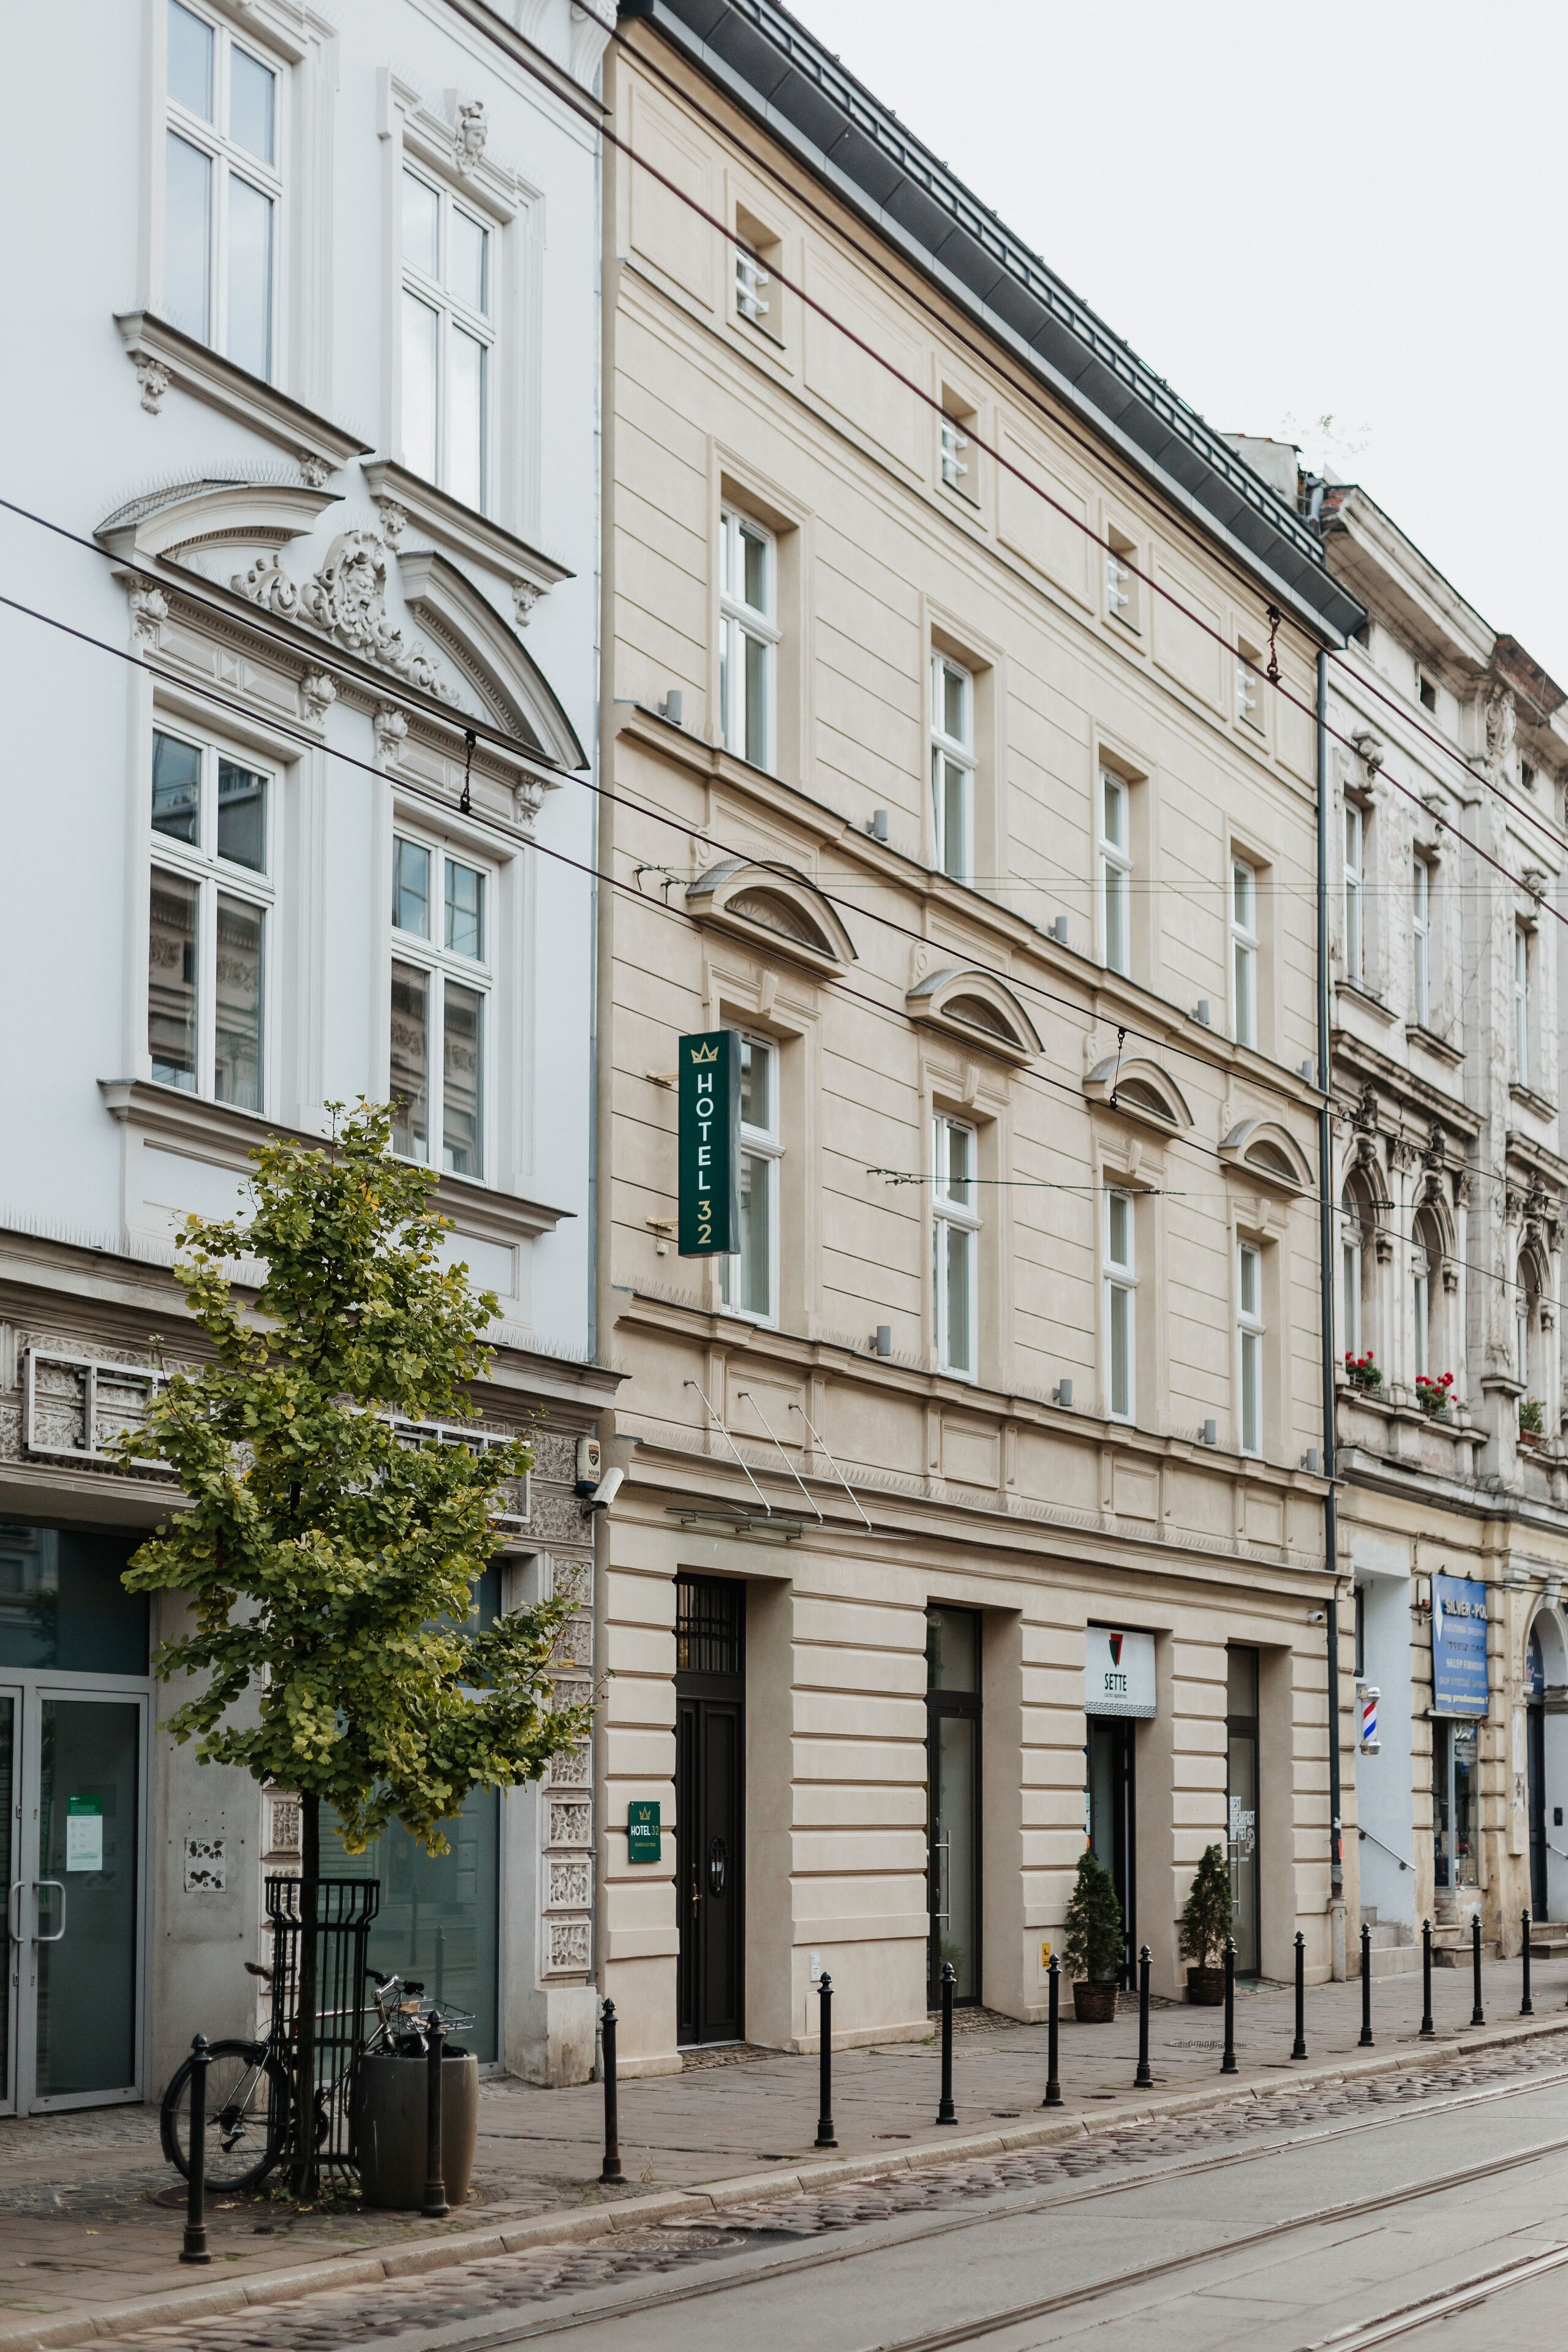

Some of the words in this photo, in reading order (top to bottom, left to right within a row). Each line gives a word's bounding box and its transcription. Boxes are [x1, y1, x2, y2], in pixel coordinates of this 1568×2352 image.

[696, 1072, 714, 1190] HOTEL
[697, 1200, 712, 1244] 32
[1444, 1598, 1470, 1616] SILVER
[1475, 1602, 1488, 1619] POL
[1105, 1673, 1126, 1691] SETTE
[1229, 1796, 1242, 1811] BEST
[1229, 1811, 1255, 1826] BREAKFAST
[631, 1825, 650, 1836] HOTEL
[652, 1825, 659, 1835] 32
